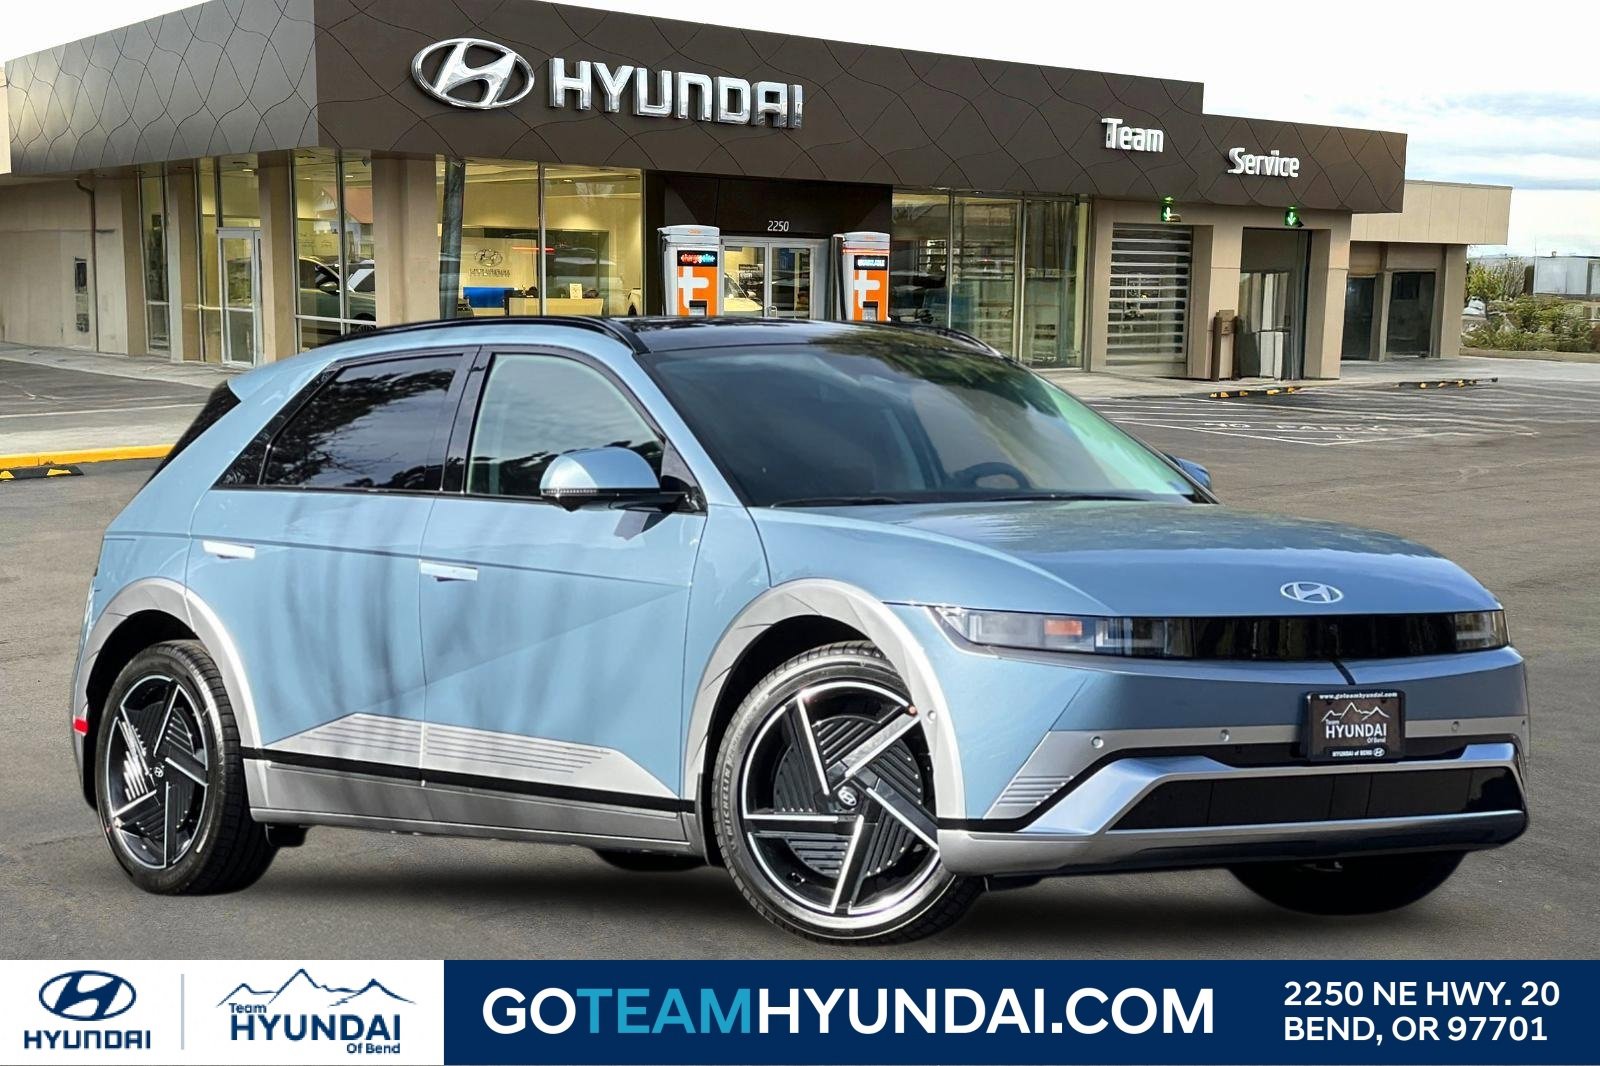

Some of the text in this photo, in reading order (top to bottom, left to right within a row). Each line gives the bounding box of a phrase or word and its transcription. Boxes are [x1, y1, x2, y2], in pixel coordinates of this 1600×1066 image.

[548, 57, 803, 128] HYUNDAI
[1101, 117, 1164, 152] Team
[1228, 147, 1300, 178] Service
[767, 220, 790, 232] 2250
[1319, 692, 1397, 700] www.goteamhyundai.com
[1325, 723, 1387, 739] HYUNDAI
[722, 767, 733, 836] MICHELIN
